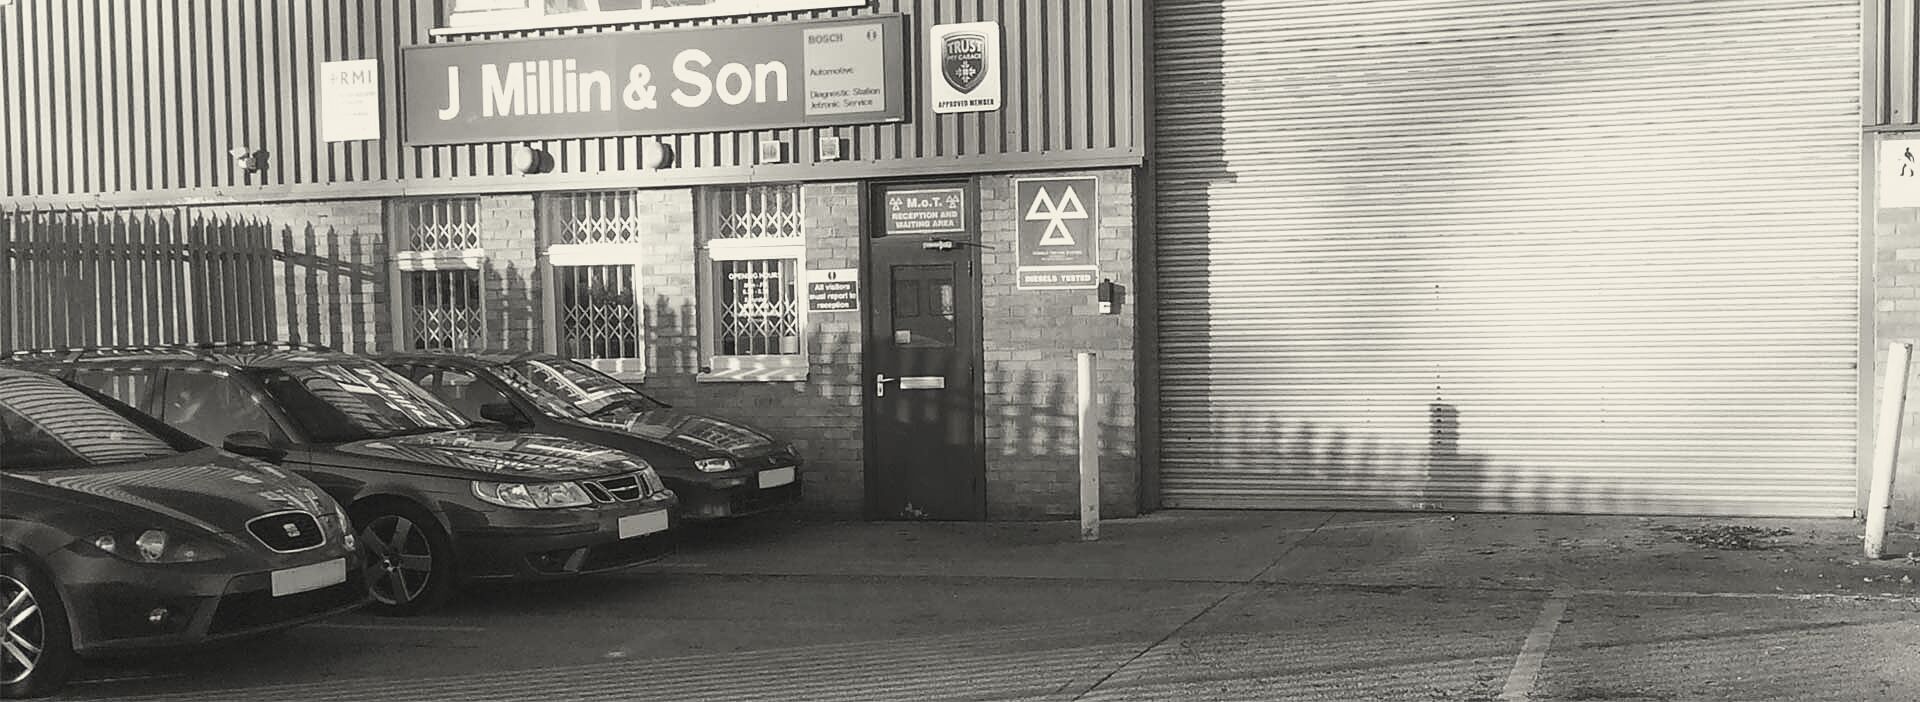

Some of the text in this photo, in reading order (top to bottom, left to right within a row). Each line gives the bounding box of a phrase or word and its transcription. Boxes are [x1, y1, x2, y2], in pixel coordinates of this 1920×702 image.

[808, 33, 843, 44] BOSCH
[947, 39, 982, 54] TRUST
[809, 67, 854, 77] Automotive
[340, 70, 372, 85] RMI
[438, 48, 788, 121] J Millin & Son
[810, 87, 881, 100] Diagnostic Station
[810, 98, 874, 110] Jetronic Service
[938, 98, 994, 108] APPROVED MEMBER
[906, 197, 943, 208] M.o.T.
[891, 210, 958, 220] RECEPTION AND
[895, 219, 954, 229] WAITING AREA
[1061, 274, 1091, 282] TESTED
[827, 293, 848, 301] report
[816, 301, 850, 309] reception
